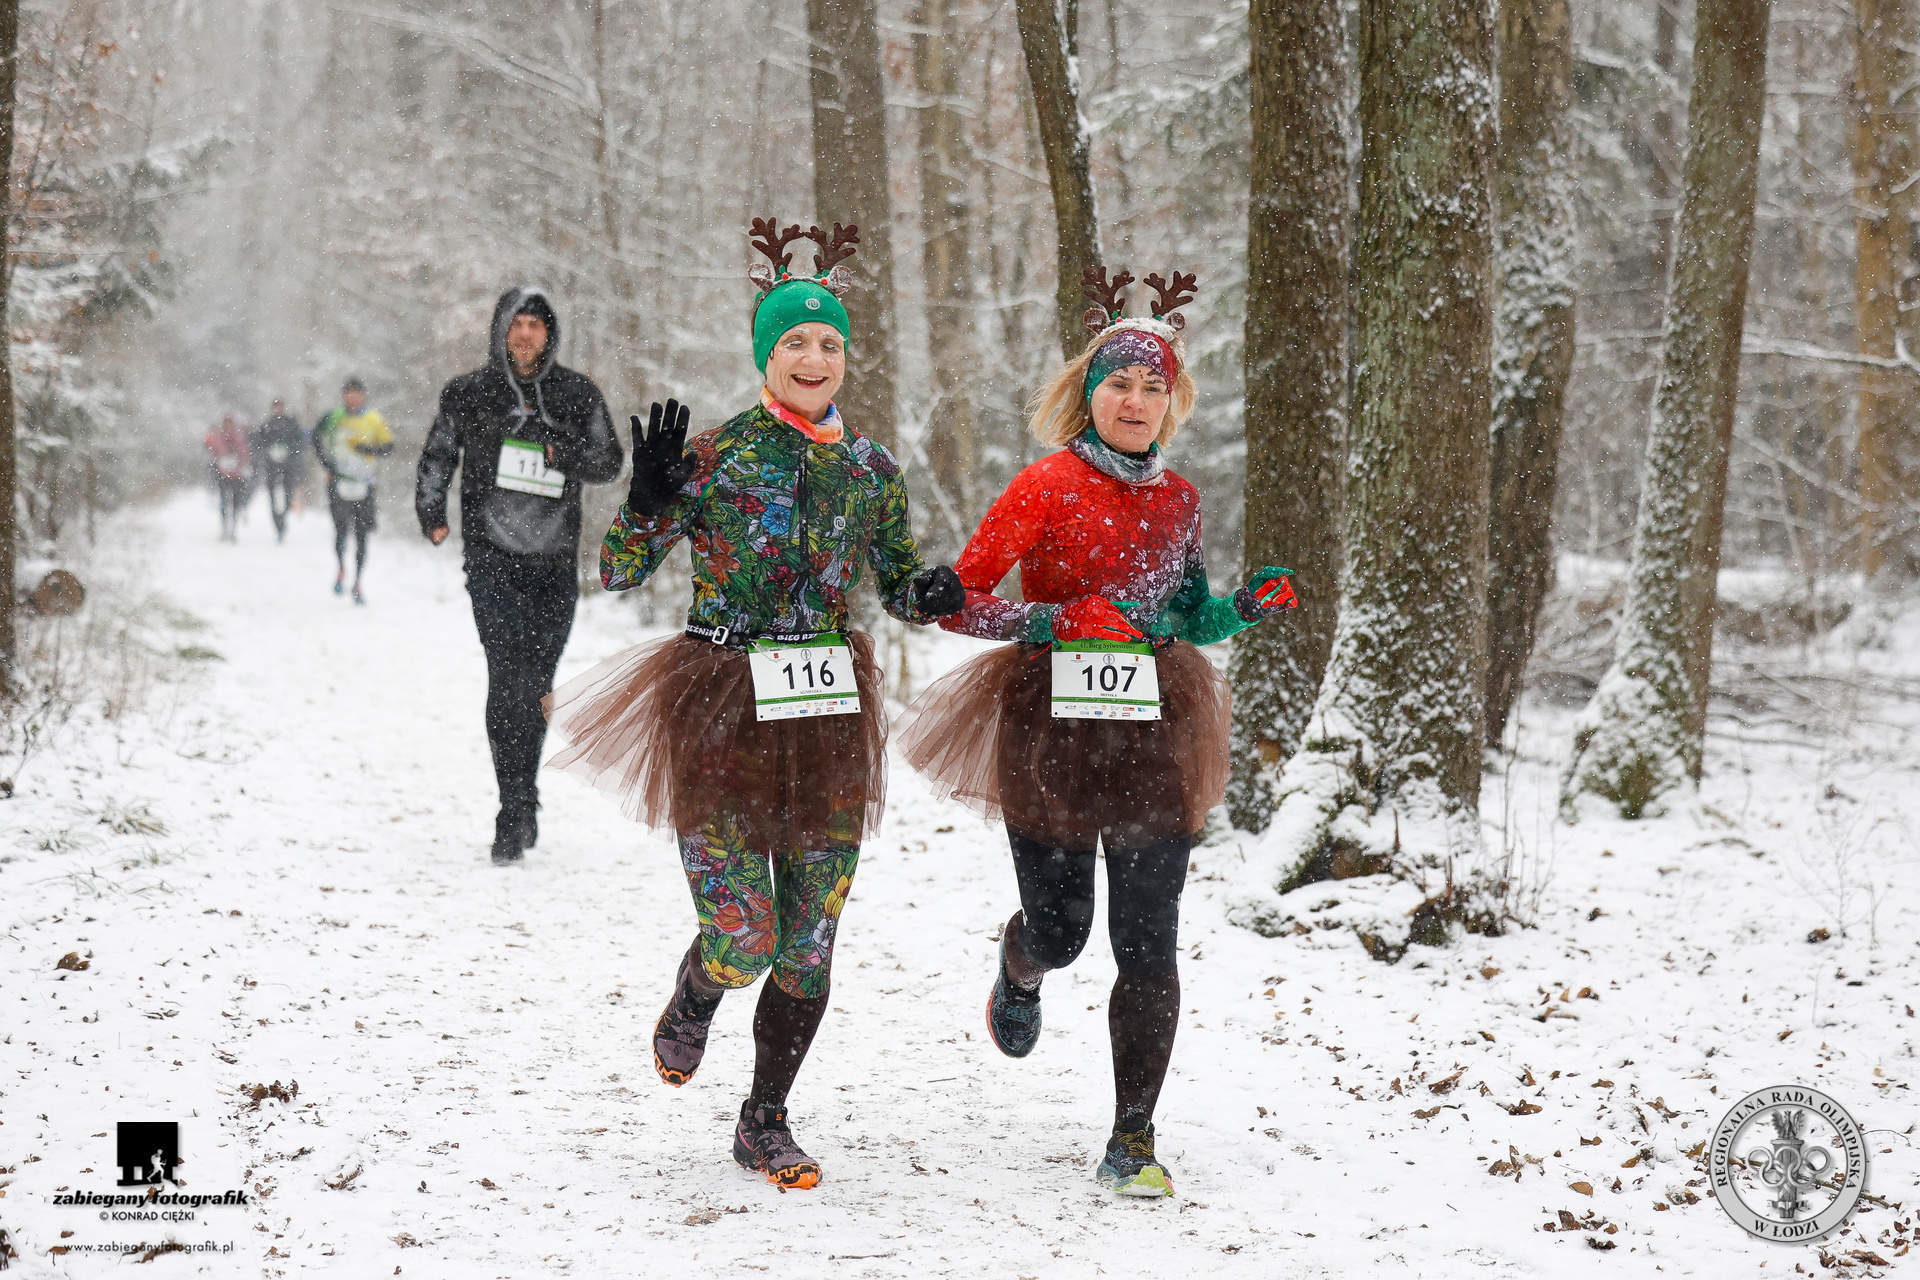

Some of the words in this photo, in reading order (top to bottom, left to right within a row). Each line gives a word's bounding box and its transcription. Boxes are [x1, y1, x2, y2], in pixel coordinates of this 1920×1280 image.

[777, 633, 800, 642] BIEG
[782, 659, 835, 690] 116
[1081, 664, 1138, 692] 107
